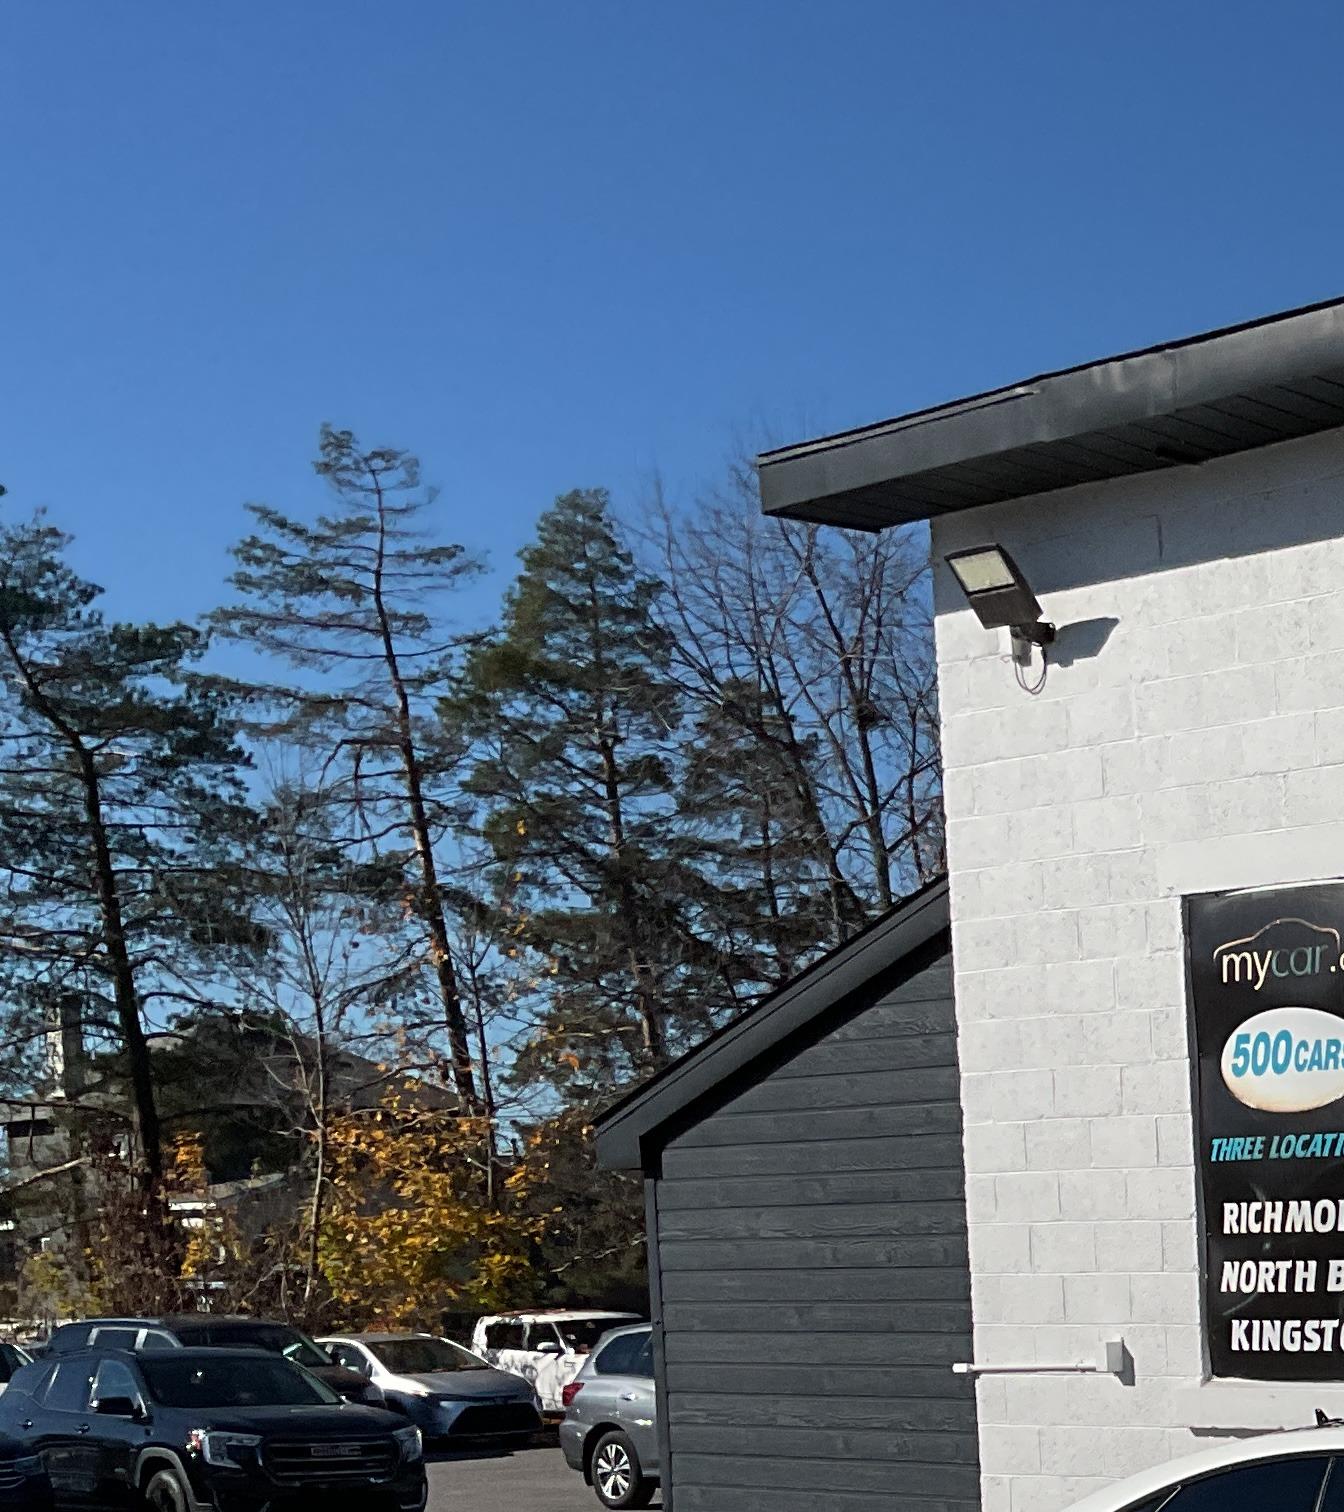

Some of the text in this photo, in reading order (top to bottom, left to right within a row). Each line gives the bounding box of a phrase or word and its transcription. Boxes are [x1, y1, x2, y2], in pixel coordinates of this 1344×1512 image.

[1230, 1029, 1293, 1079] 500
[1210, 1135, 1267, 1163] THREE
[1219, 1258, 1318, 1294] NORTH
